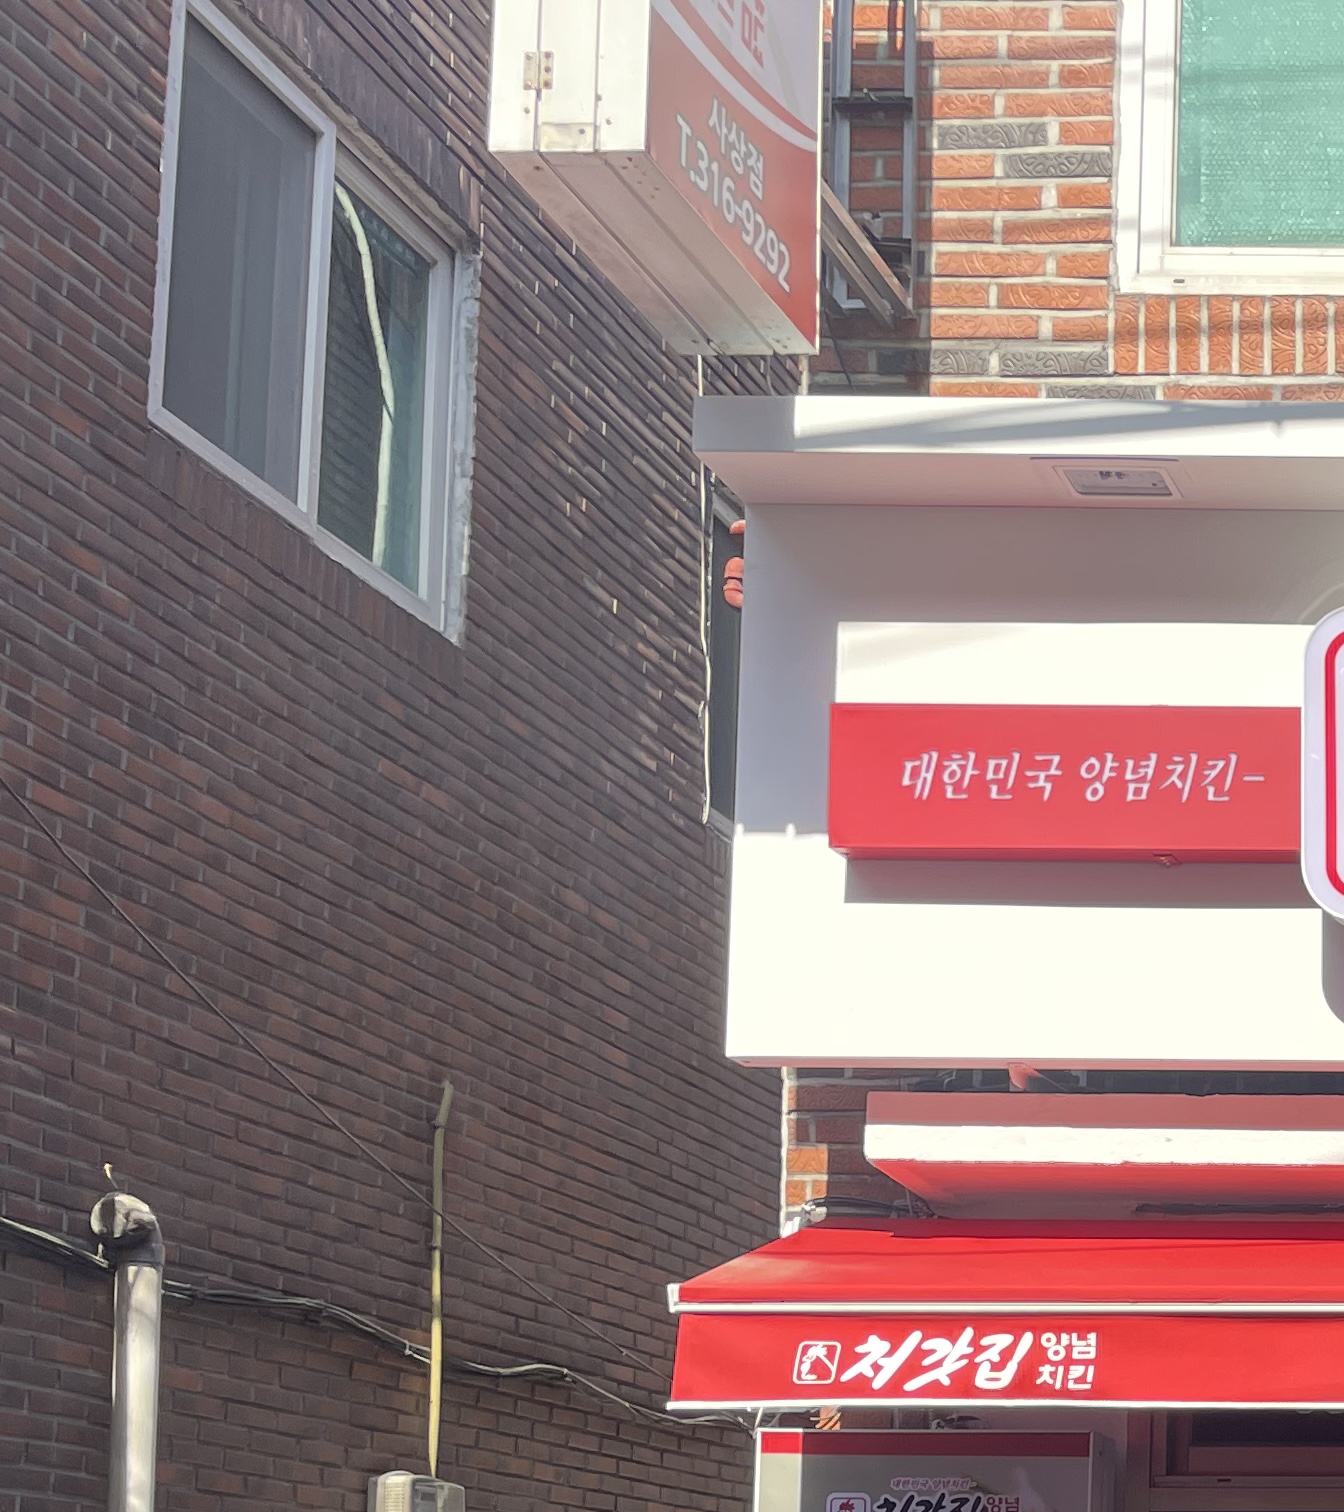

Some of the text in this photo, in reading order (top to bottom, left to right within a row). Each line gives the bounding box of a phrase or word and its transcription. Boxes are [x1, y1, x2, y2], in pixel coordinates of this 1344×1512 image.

[709, 98, 763, 200] 사상점
[901, 750, 1062, 801] 대한민국
[840, 1326, 1033, 1392] 처갓집
[1040, 1332, 1097, 1362] 양념
[1036, 1364, 1095, 1391] 치킨
